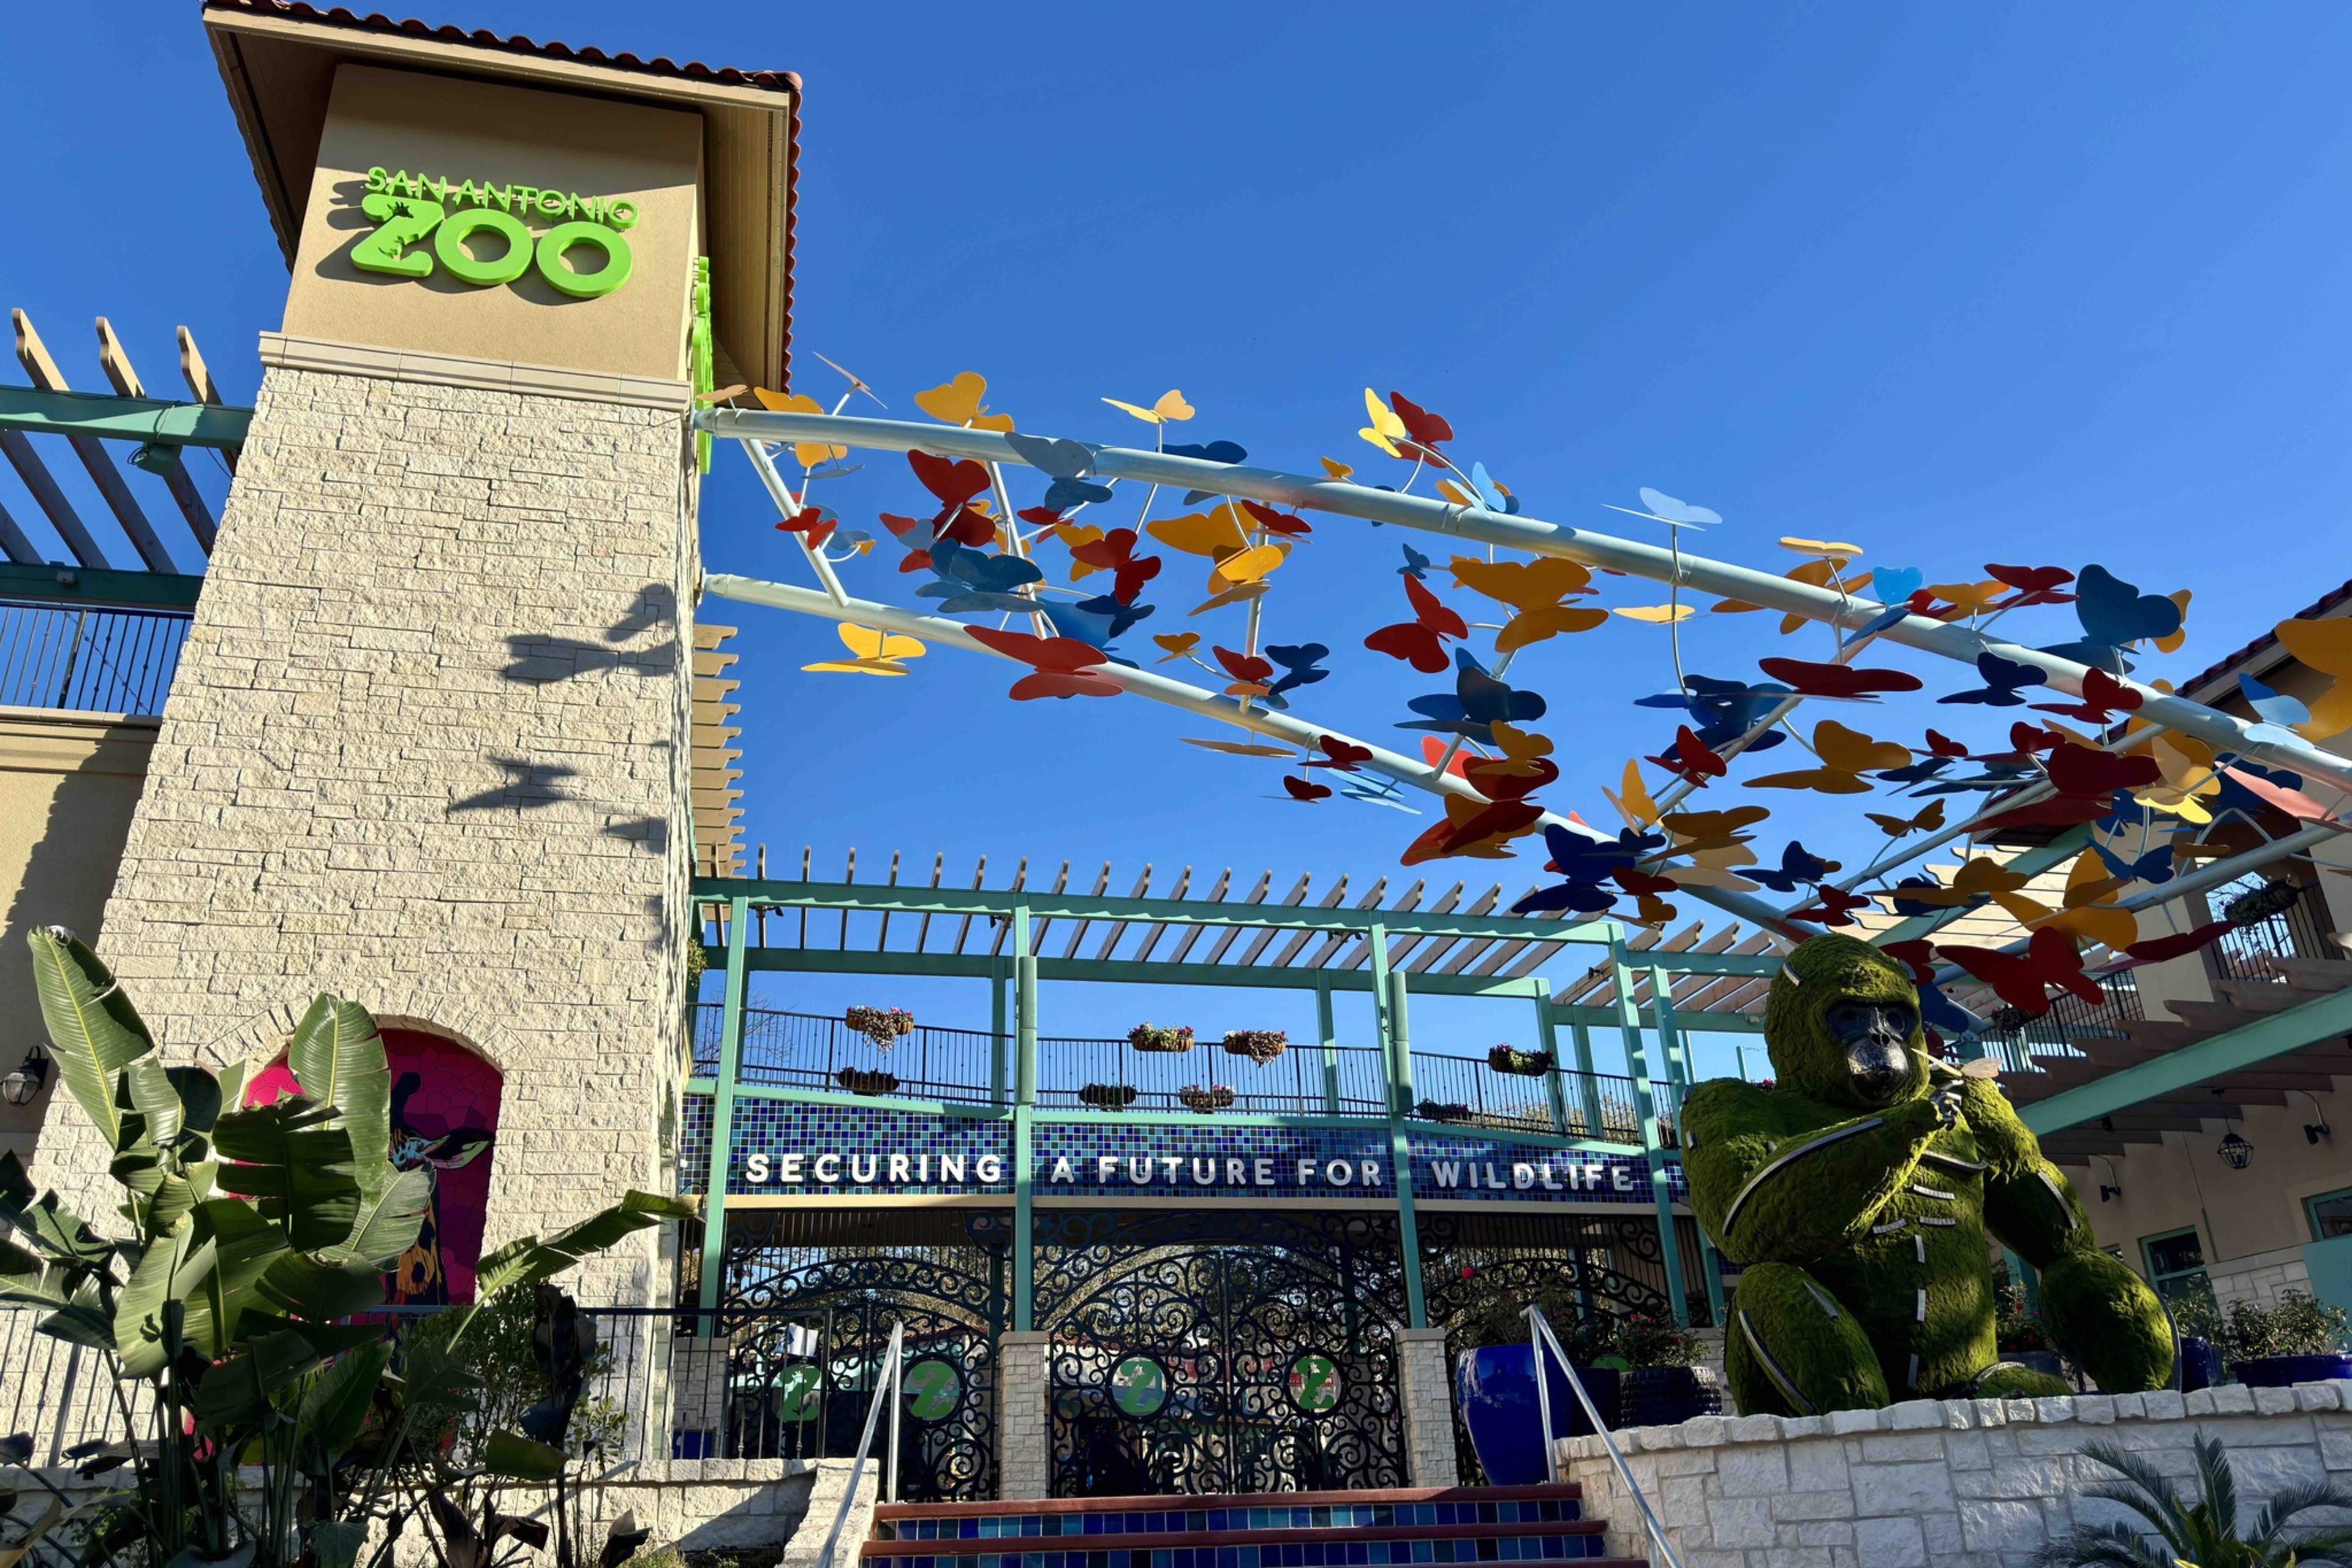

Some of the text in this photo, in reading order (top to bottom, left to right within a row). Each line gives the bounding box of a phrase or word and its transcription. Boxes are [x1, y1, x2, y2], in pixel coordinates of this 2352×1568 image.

[365, 167, 639, 228] SAN ANTONIO
[350, 194, 632, 298] ZOO
[745, 1153, 1634, 1192] SECURING A FUTURE FOR WILDLIFE
